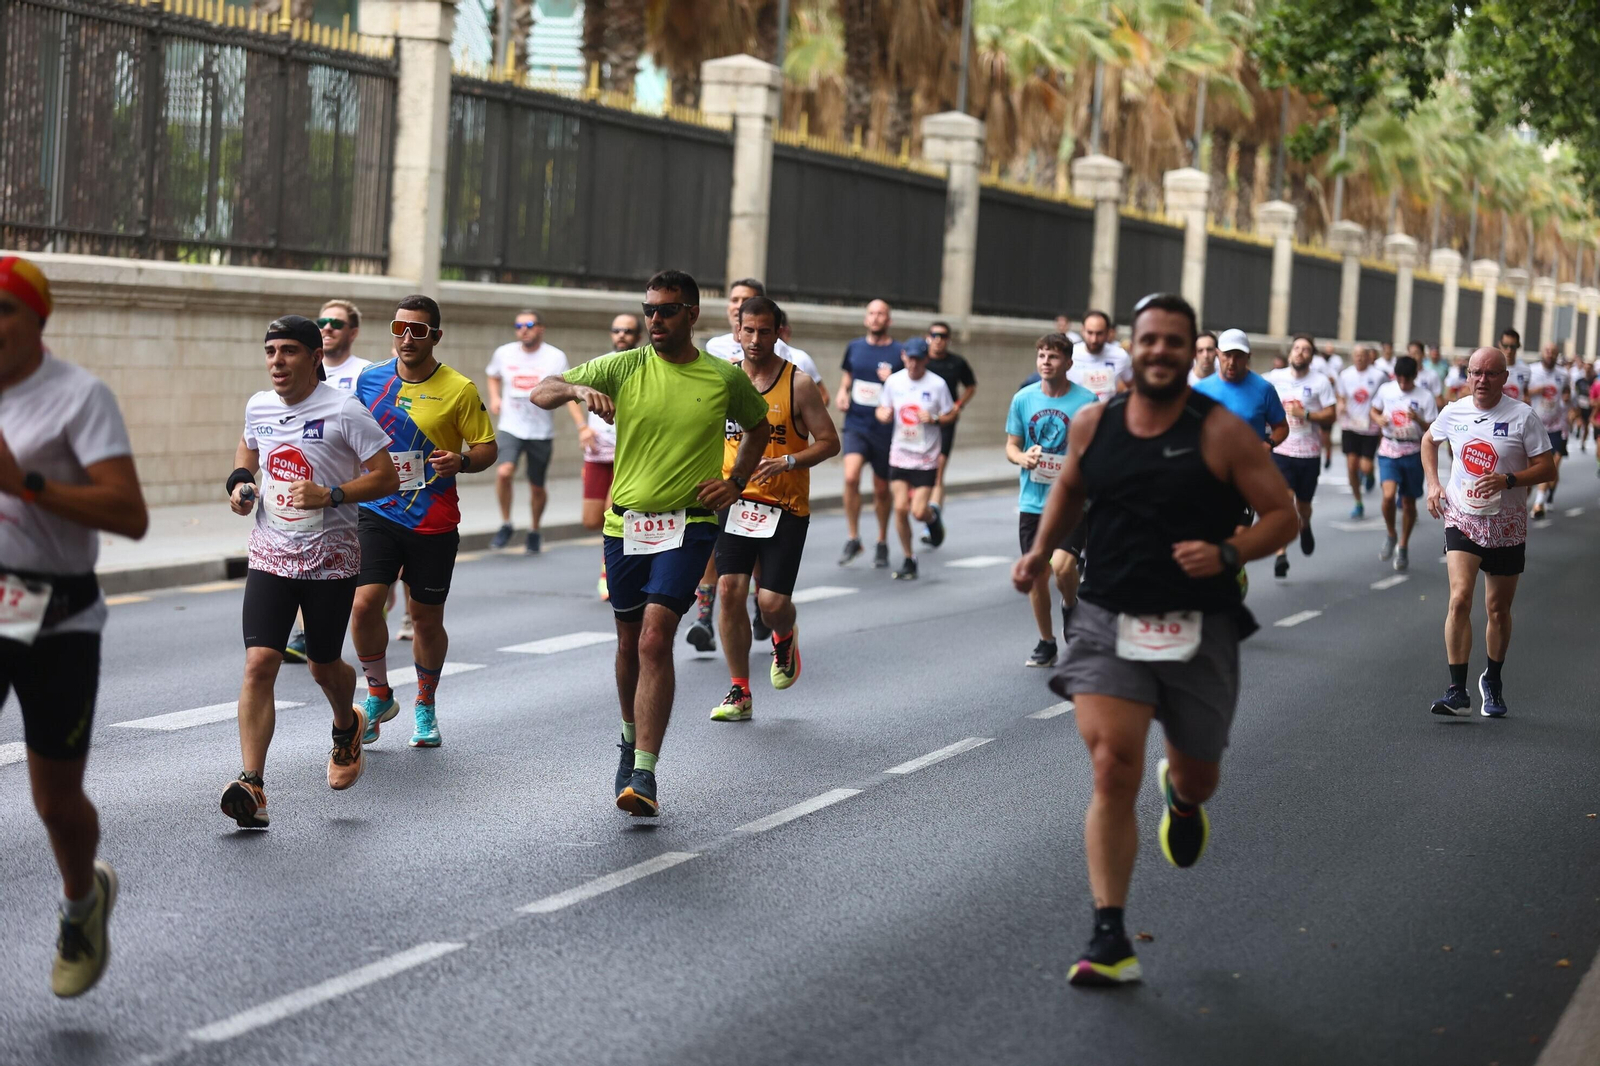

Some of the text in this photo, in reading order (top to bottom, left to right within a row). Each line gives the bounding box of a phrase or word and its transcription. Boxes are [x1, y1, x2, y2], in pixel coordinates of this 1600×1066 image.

[302, 428, 320, 438] AXA
[1466, 446, 1494, 461] PONLE
[273, 456, 307, 475] PONLE
[1464, 454, 1491, 469] FRENO
[741, 510, 768, 524] 652
[634, 518, 676, 533] 1011
